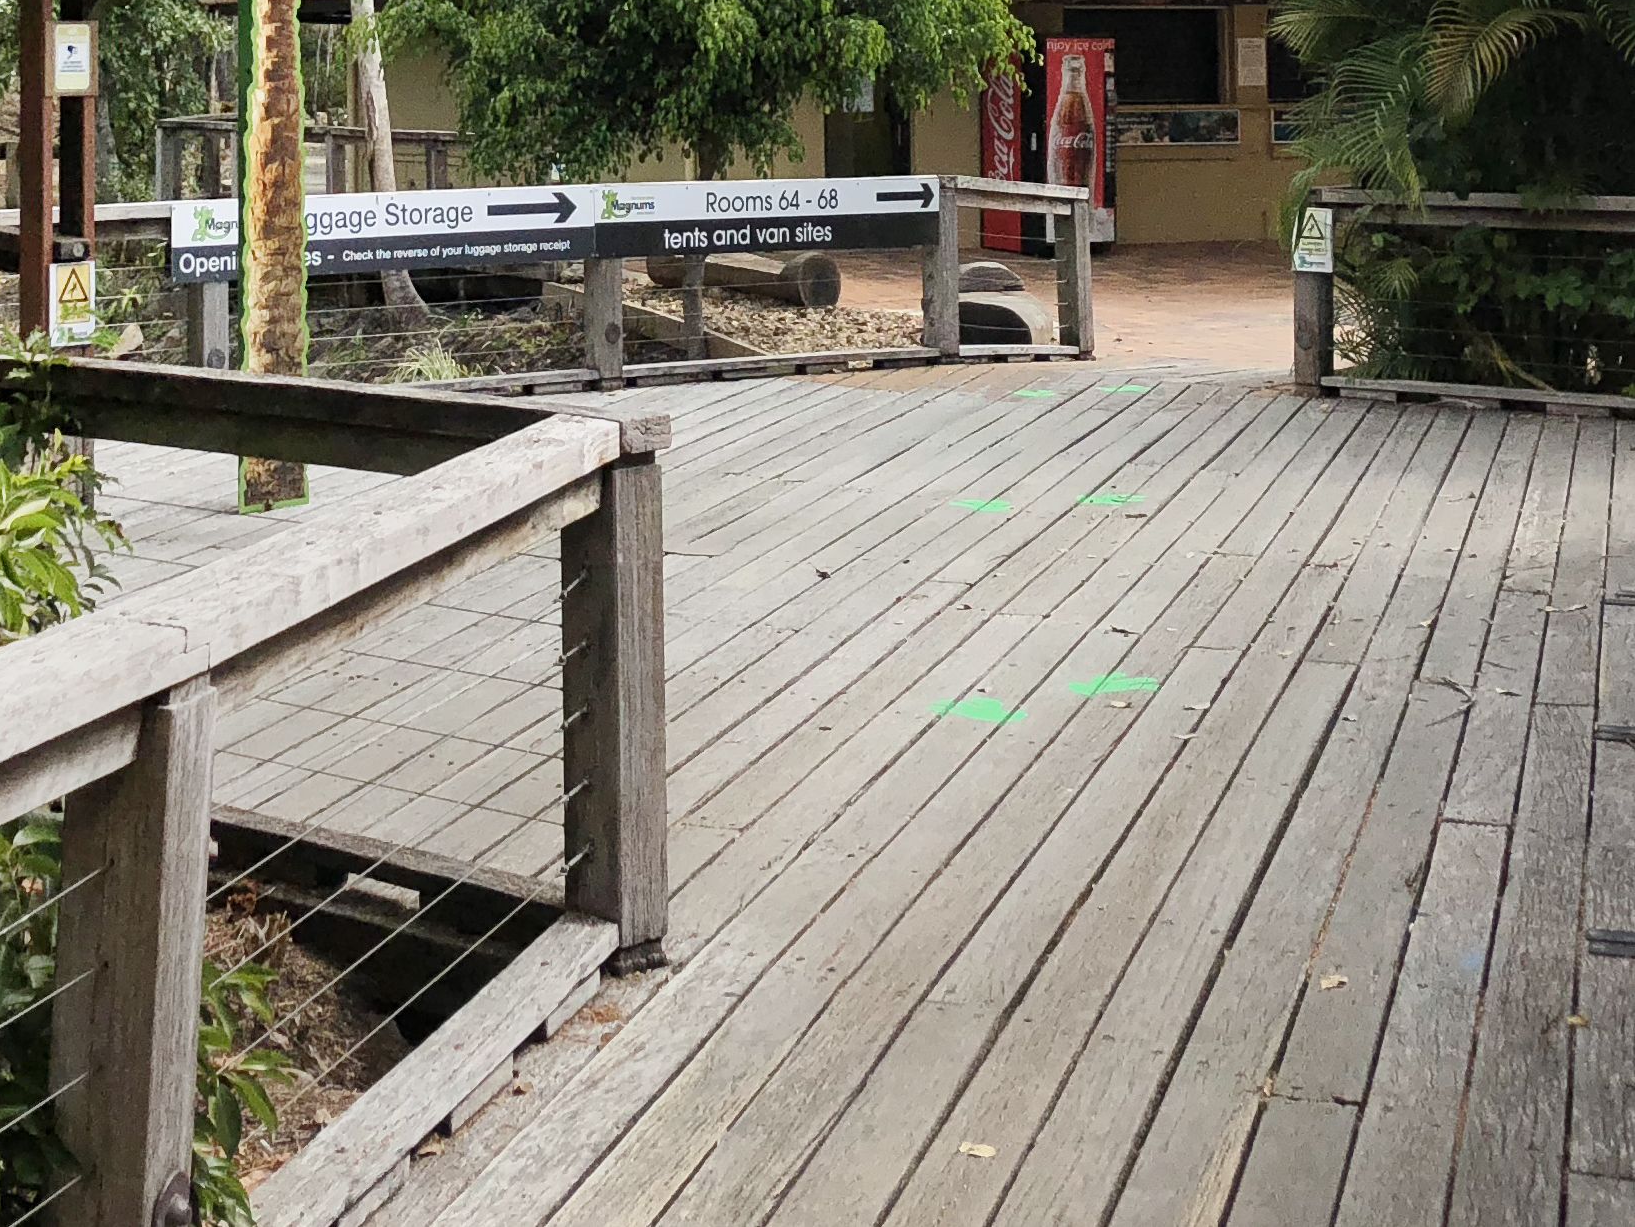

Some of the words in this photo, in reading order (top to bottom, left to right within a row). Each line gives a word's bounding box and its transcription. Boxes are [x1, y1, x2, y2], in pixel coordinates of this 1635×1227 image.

[1046, 41, 1070, 52] njoy
[706, 192, 773, 213] Rooms
[778, 189, 800, 211] 64
[817, 188, 839, 210] 68
[205, 217, 239, 235] Magn
[304, 209, 377, 236] ggage
[384, 202, 474, 230] Storage
[663, 226, 708, 250] tents
[712, 224, 751, 246] and
[756, 226, 790, 245] van
[795, 222, 833, 243] sites
[178, 250, 238, 278] Openi
[342, 249, 374, 262] Check
[376, 248, 392, 260] the
[393, 247, 429, 259] reverse
[430, 245, 440, 257] of
[441, 245, 464, 259] your
[465, 243, 502, 257] luggage
[503, 242, 538, 254] storage
[539, 239, 571, 252] receipt
